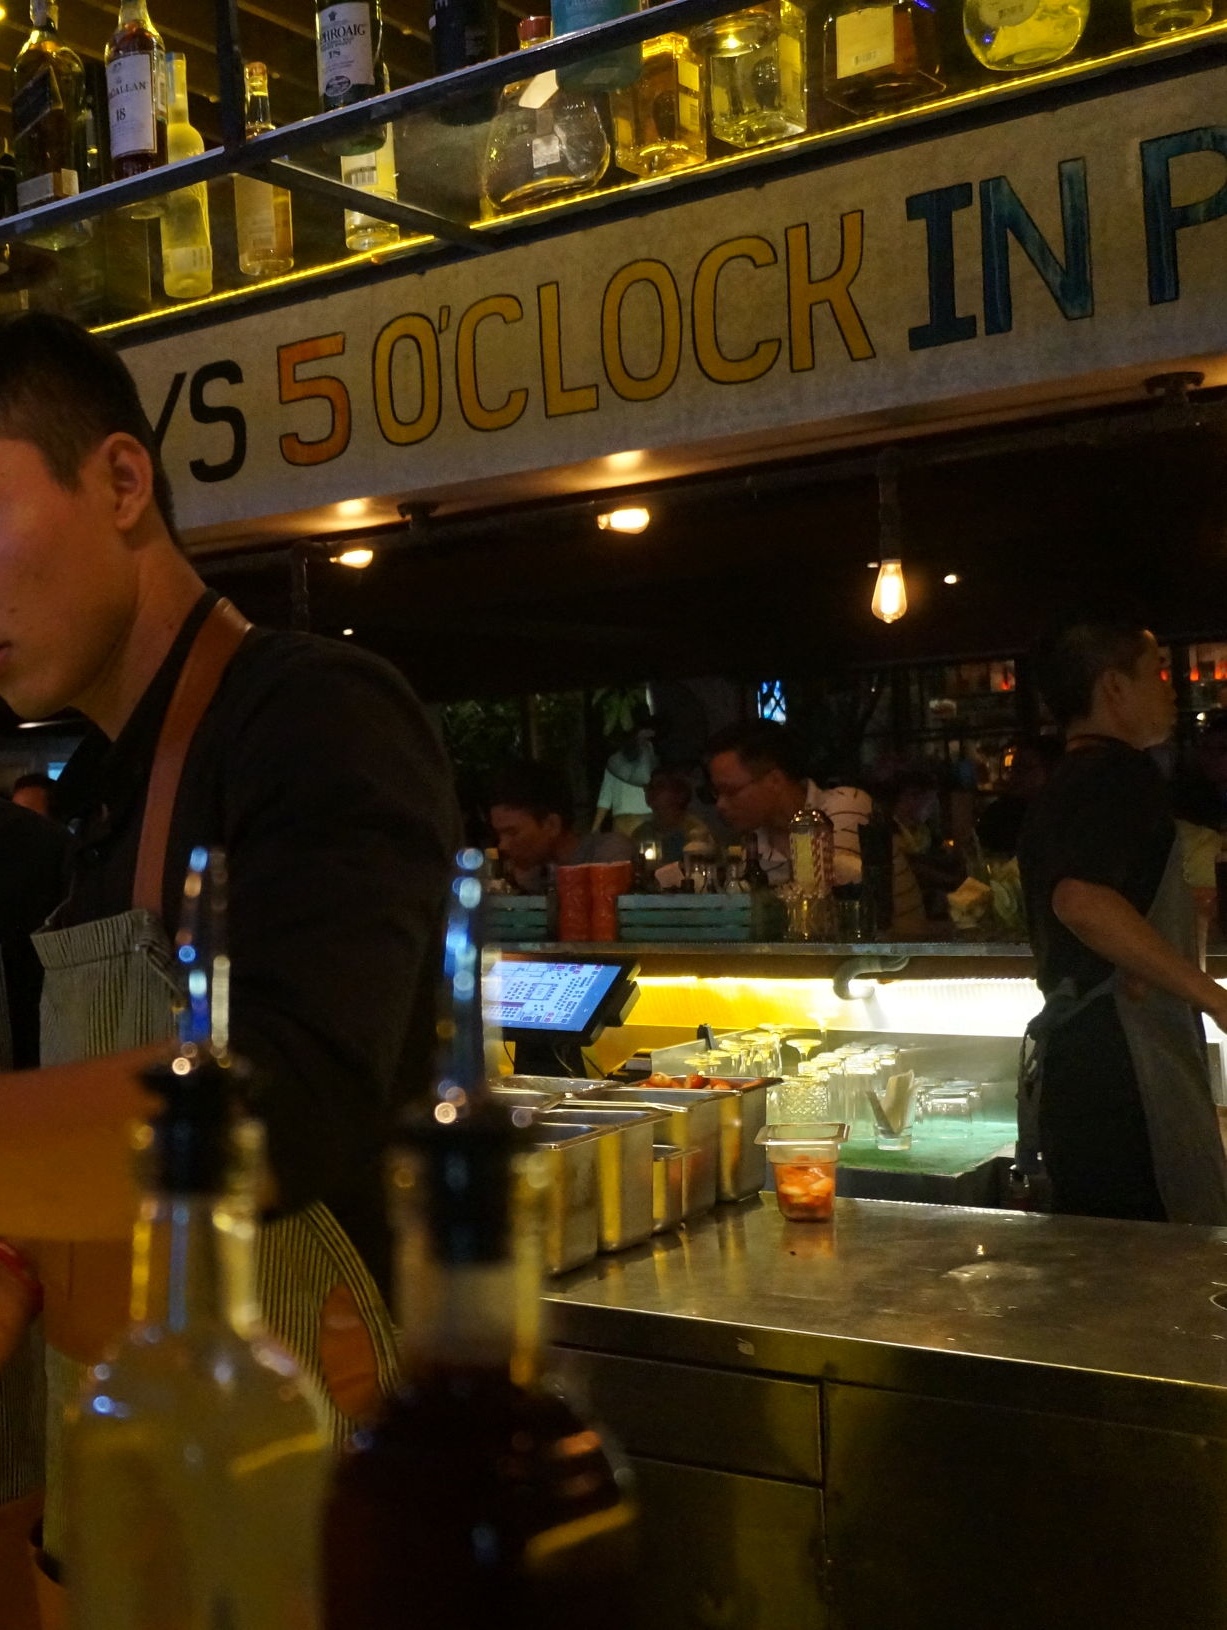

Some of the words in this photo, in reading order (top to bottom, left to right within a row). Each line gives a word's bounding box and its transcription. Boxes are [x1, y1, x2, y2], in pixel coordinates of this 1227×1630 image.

[116, 108, 126, 121] 18
[276, 332, 351, 466] 5
[372, 210, 876, 446] O'CLOCK
[906, 157, 1094, 350] IN
